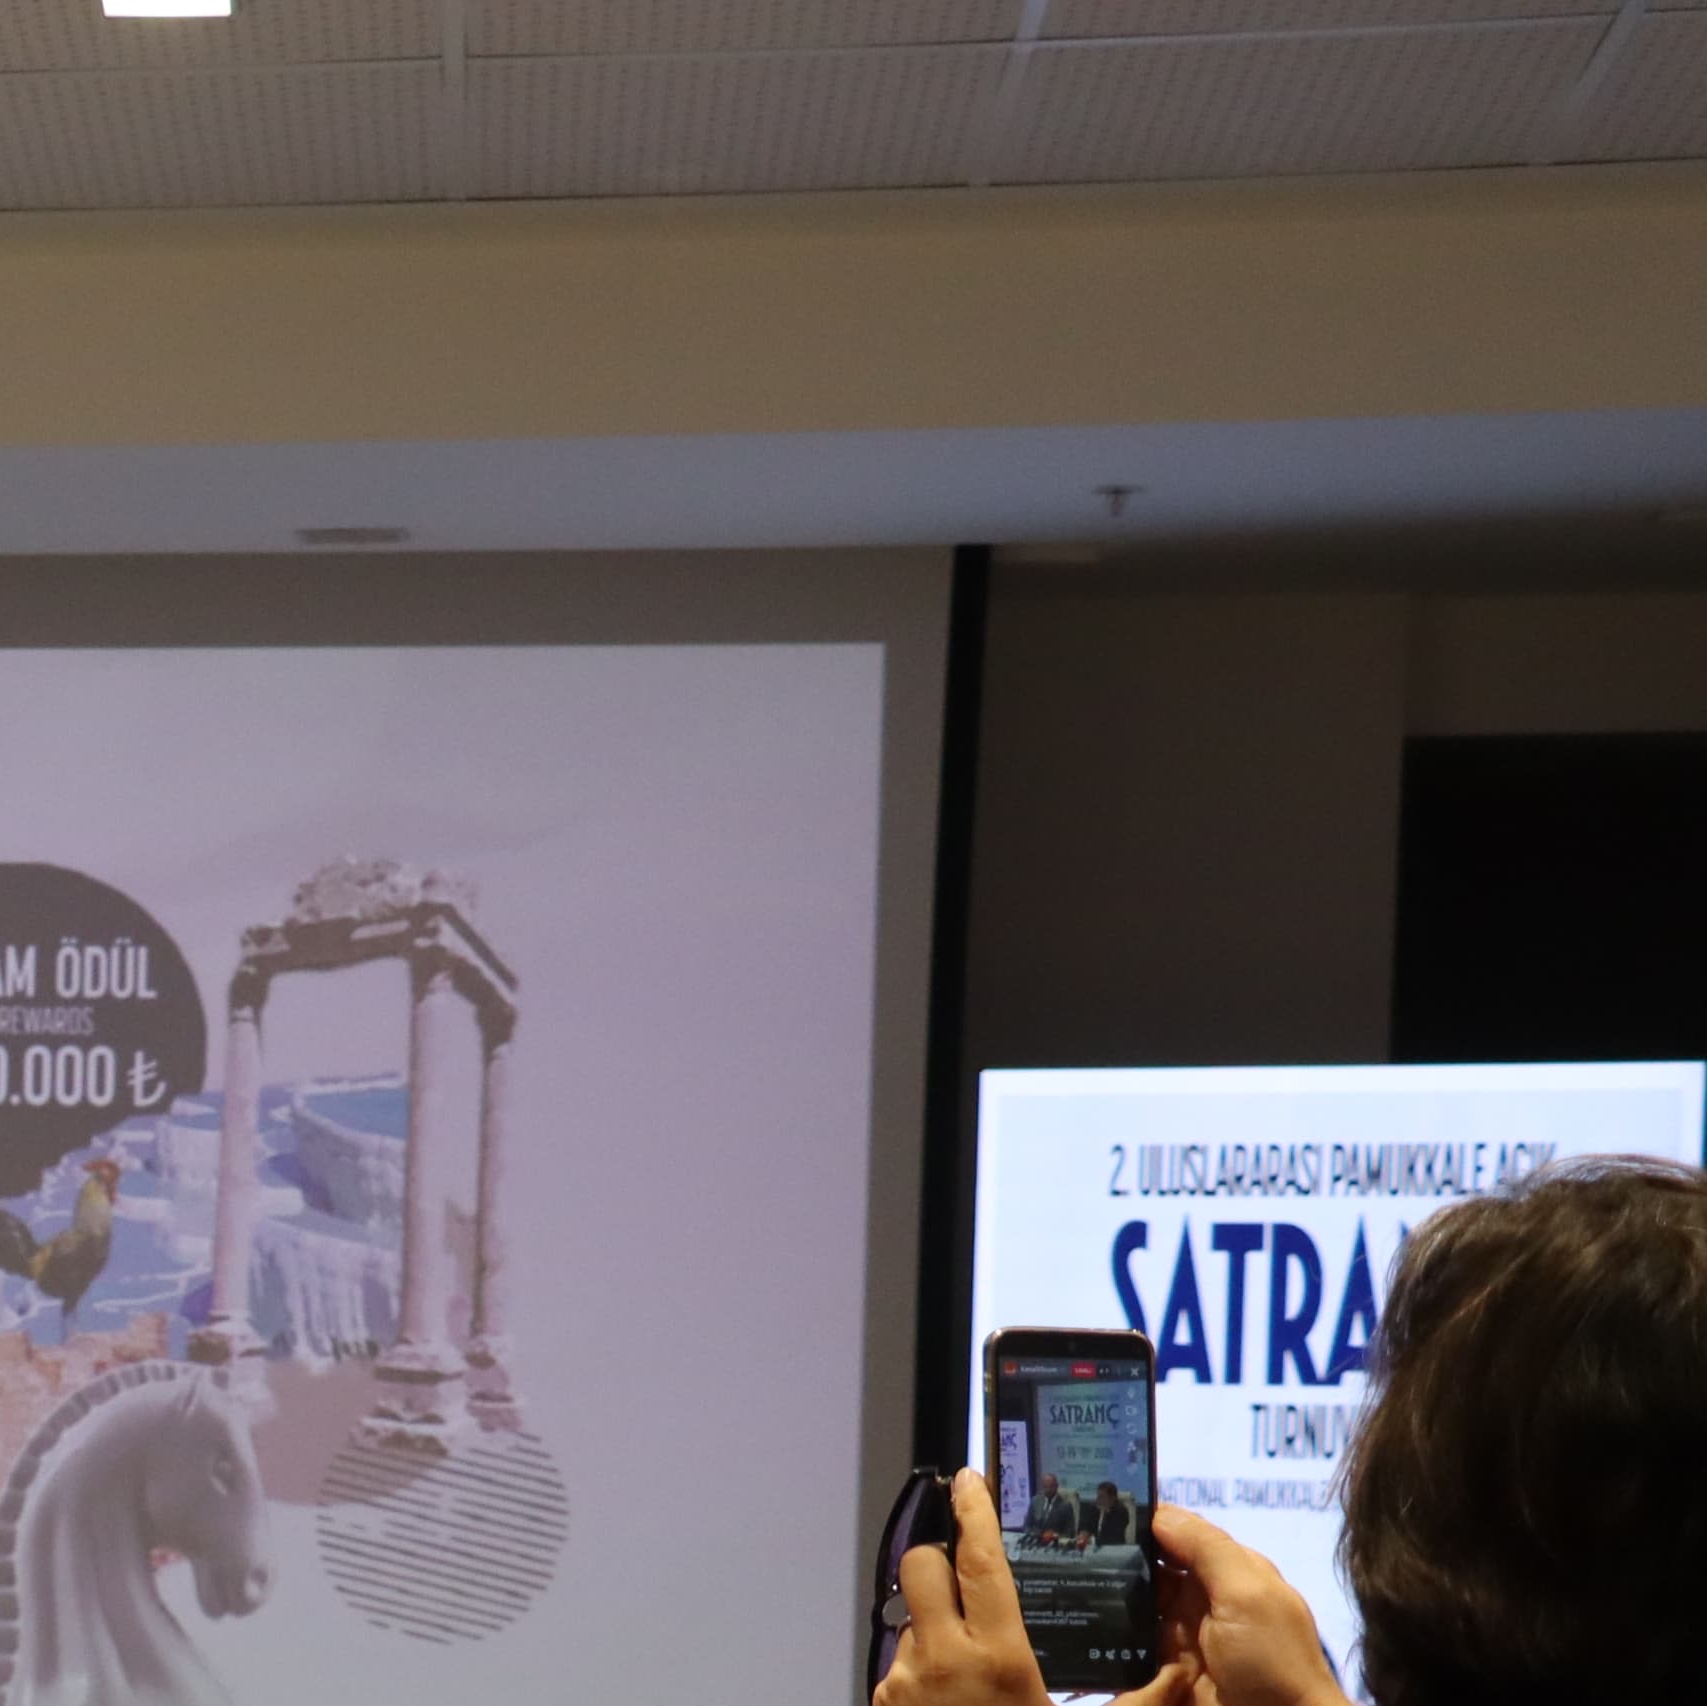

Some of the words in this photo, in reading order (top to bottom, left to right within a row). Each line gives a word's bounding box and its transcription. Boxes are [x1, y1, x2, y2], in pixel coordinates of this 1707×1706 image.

[55, 936, 158, 999] ÖDÜL
[1138, 1143, 1323, 1197] ULUSLARARASI
[1330, 1142, 1487, 1197] PAMUKKALE
[1111, 1212, 1410, 1386] SATRA
[1050, 1403, 1120, 1429] SATRANÇ
